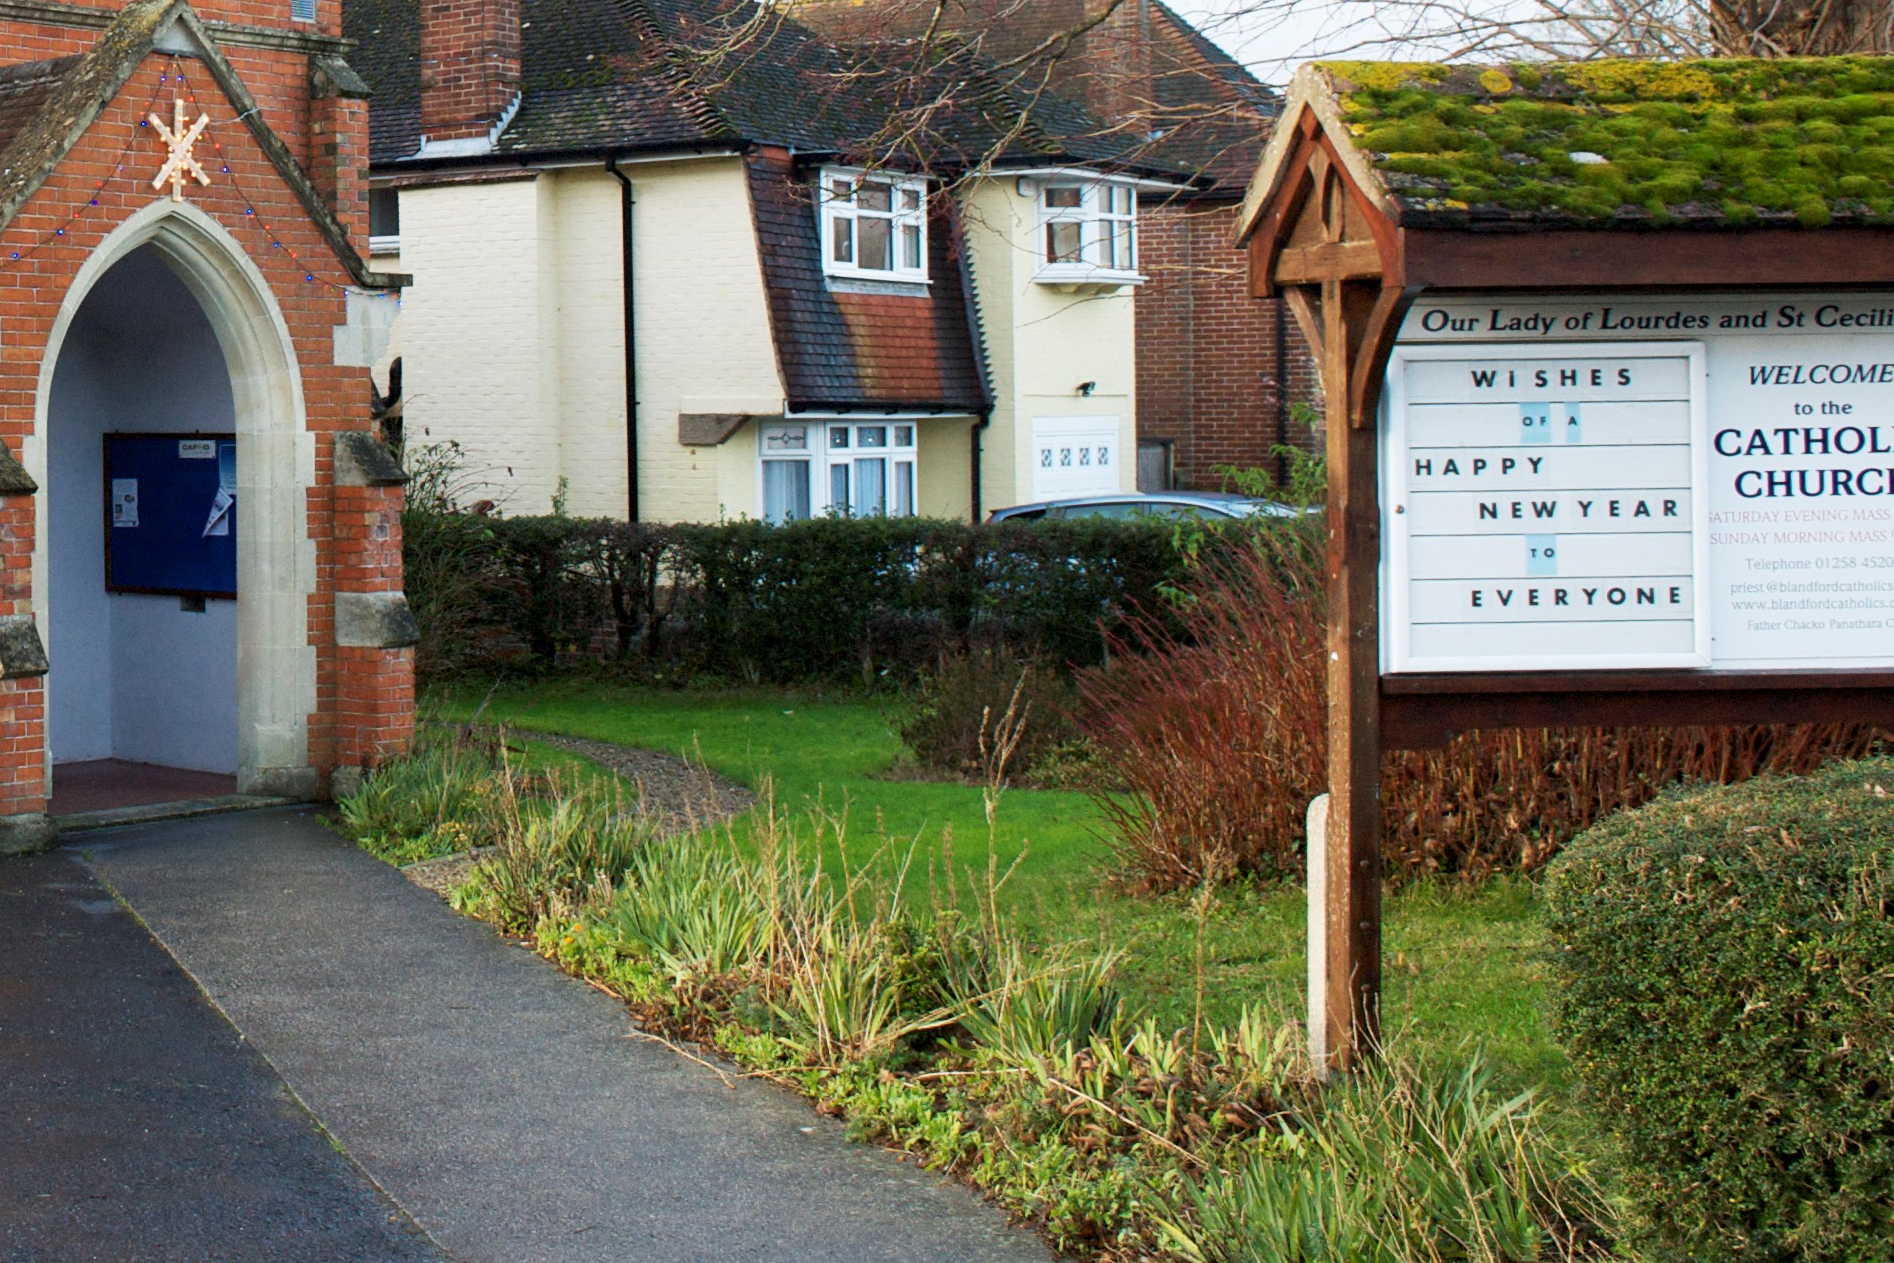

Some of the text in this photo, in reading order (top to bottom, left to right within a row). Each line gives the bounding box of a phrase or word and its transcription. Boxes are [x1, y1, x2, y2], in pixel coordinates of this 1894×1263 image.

[1422, 305, 1894, 335] Our Lady of Lourdes and St Cecili
[1471, 368, 1632, 387] WISHES
[1749, 363, 1894, 385] WELCOME
[1794, 401, 1853, 415] to the
[1522, 416, 1578, 427] OF A
[1713, 426, 1894, 457] CATHOL
[1414, 457, 1544, 476] HAPPY
[1479, 499, 1678, 519] NEW YEAR
[1784, 509, 1848, 522] EVENING
[1852, 507, 1891, 521] MASS
[1710, 532, 1769, 545] SUNDAY
[1773, 530, 1845, 544] MORNING
[1849, 529, 1888, 542] MASS
[1530, 548, 1555, 558] TO
[1745, 557, 1812, 572] Telephone
[1815, 556, 1857, 570] 01258
[1471, 587, 1681, 607] EVERYONE
[1747, 620, 1782, 631] Father
[1784, 619, 1825, 630] Chacko
[1829, 618, 1882, 630] Panathara
